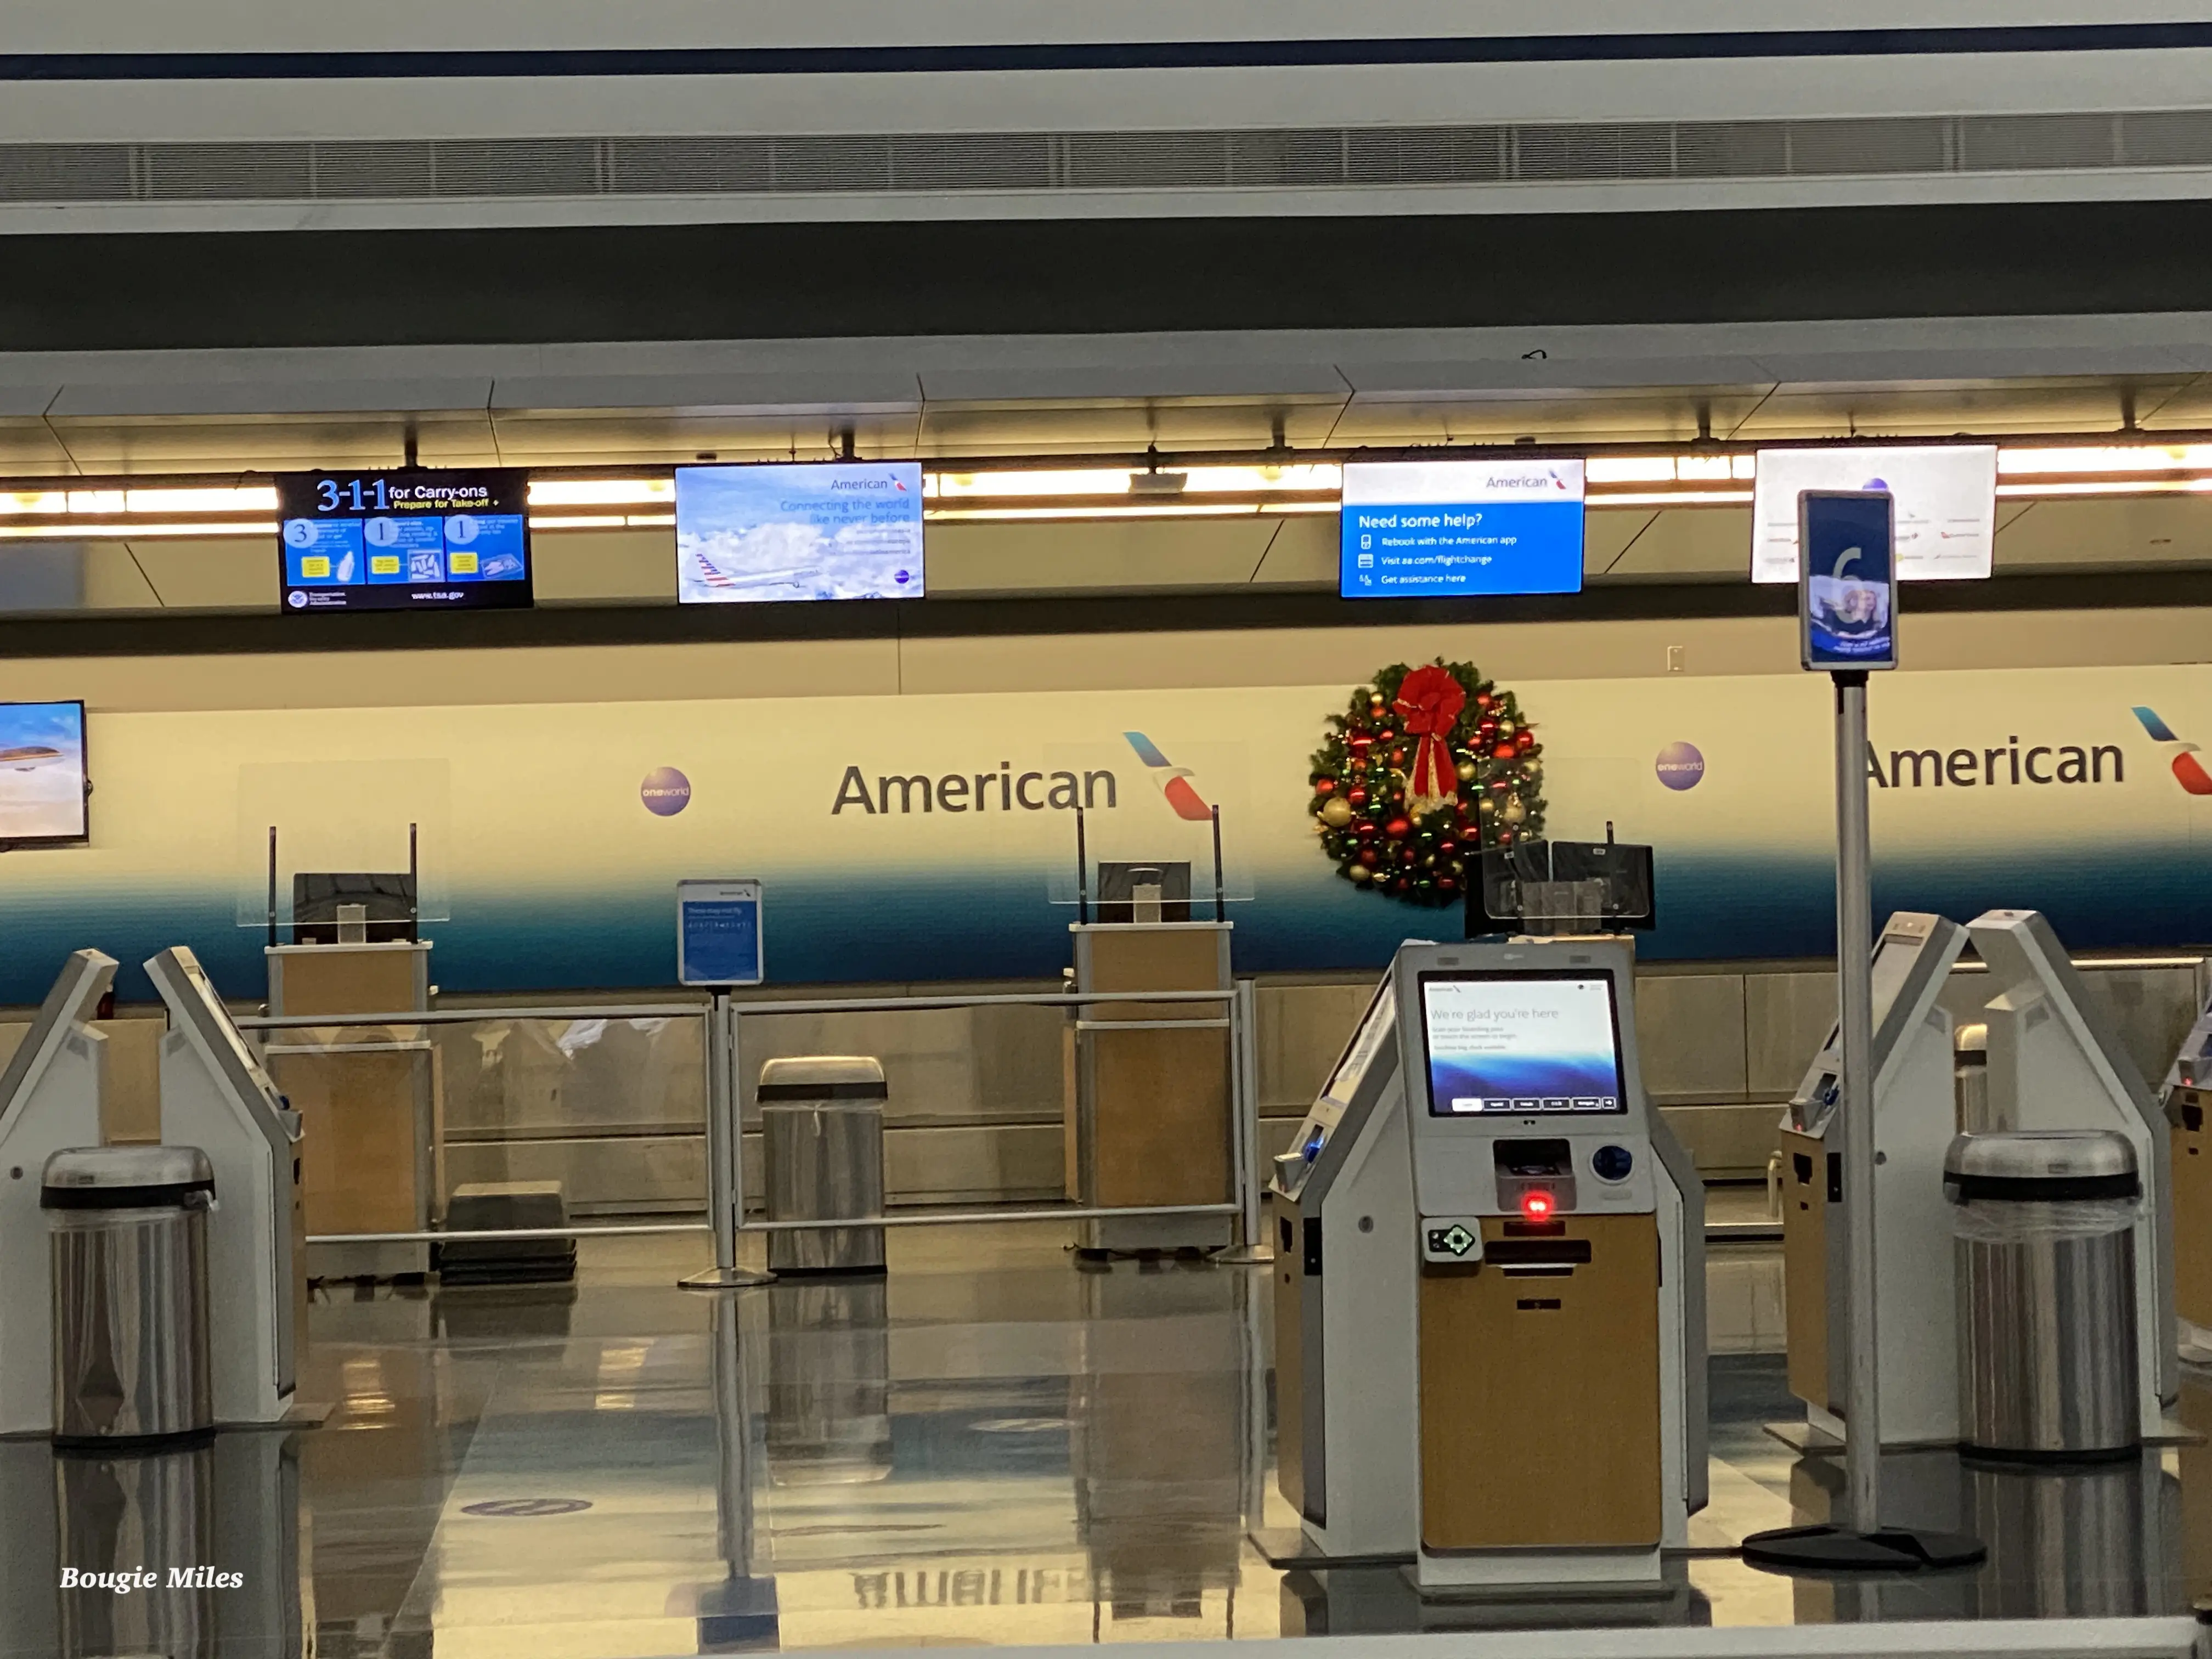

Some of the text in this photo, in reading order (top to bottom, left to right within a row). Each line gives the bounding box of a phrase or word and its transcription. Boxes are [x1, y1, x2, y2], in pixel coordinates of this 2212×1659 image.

[831, 479, 887, 489] American
[1486, 476, 1548, 489] American
[317, 479, 488, 511] 3-1-1 for Carry-ons
[393, 501, 431, 509] Prepare
[452, 499, 489, 507] Take-off
[781, 498, 910, 513] Connecting the world
[810, 512, 910, 524] like never before
[1359, 513, 1482, 530] Need some help?
[294, 524, 307, 542] 3
[377, 523, 385, 540] 1
[458, 521, 466, 538] 1
[1382, 536, 1517, 546] Rebook with the American app
[1381, 555, 1492, 566] Visit aa.com/flightchange
[1381, 575, 1398, 584] Get
[1446, 574, 1466, 583] here
[411, 591, 464, 600] www.tsa.gov
[642, 787, 689, 797] oneworld
[831, 761, 1116, 815] American
[1431, 1008, 1559, 1022] We're glad you're here
